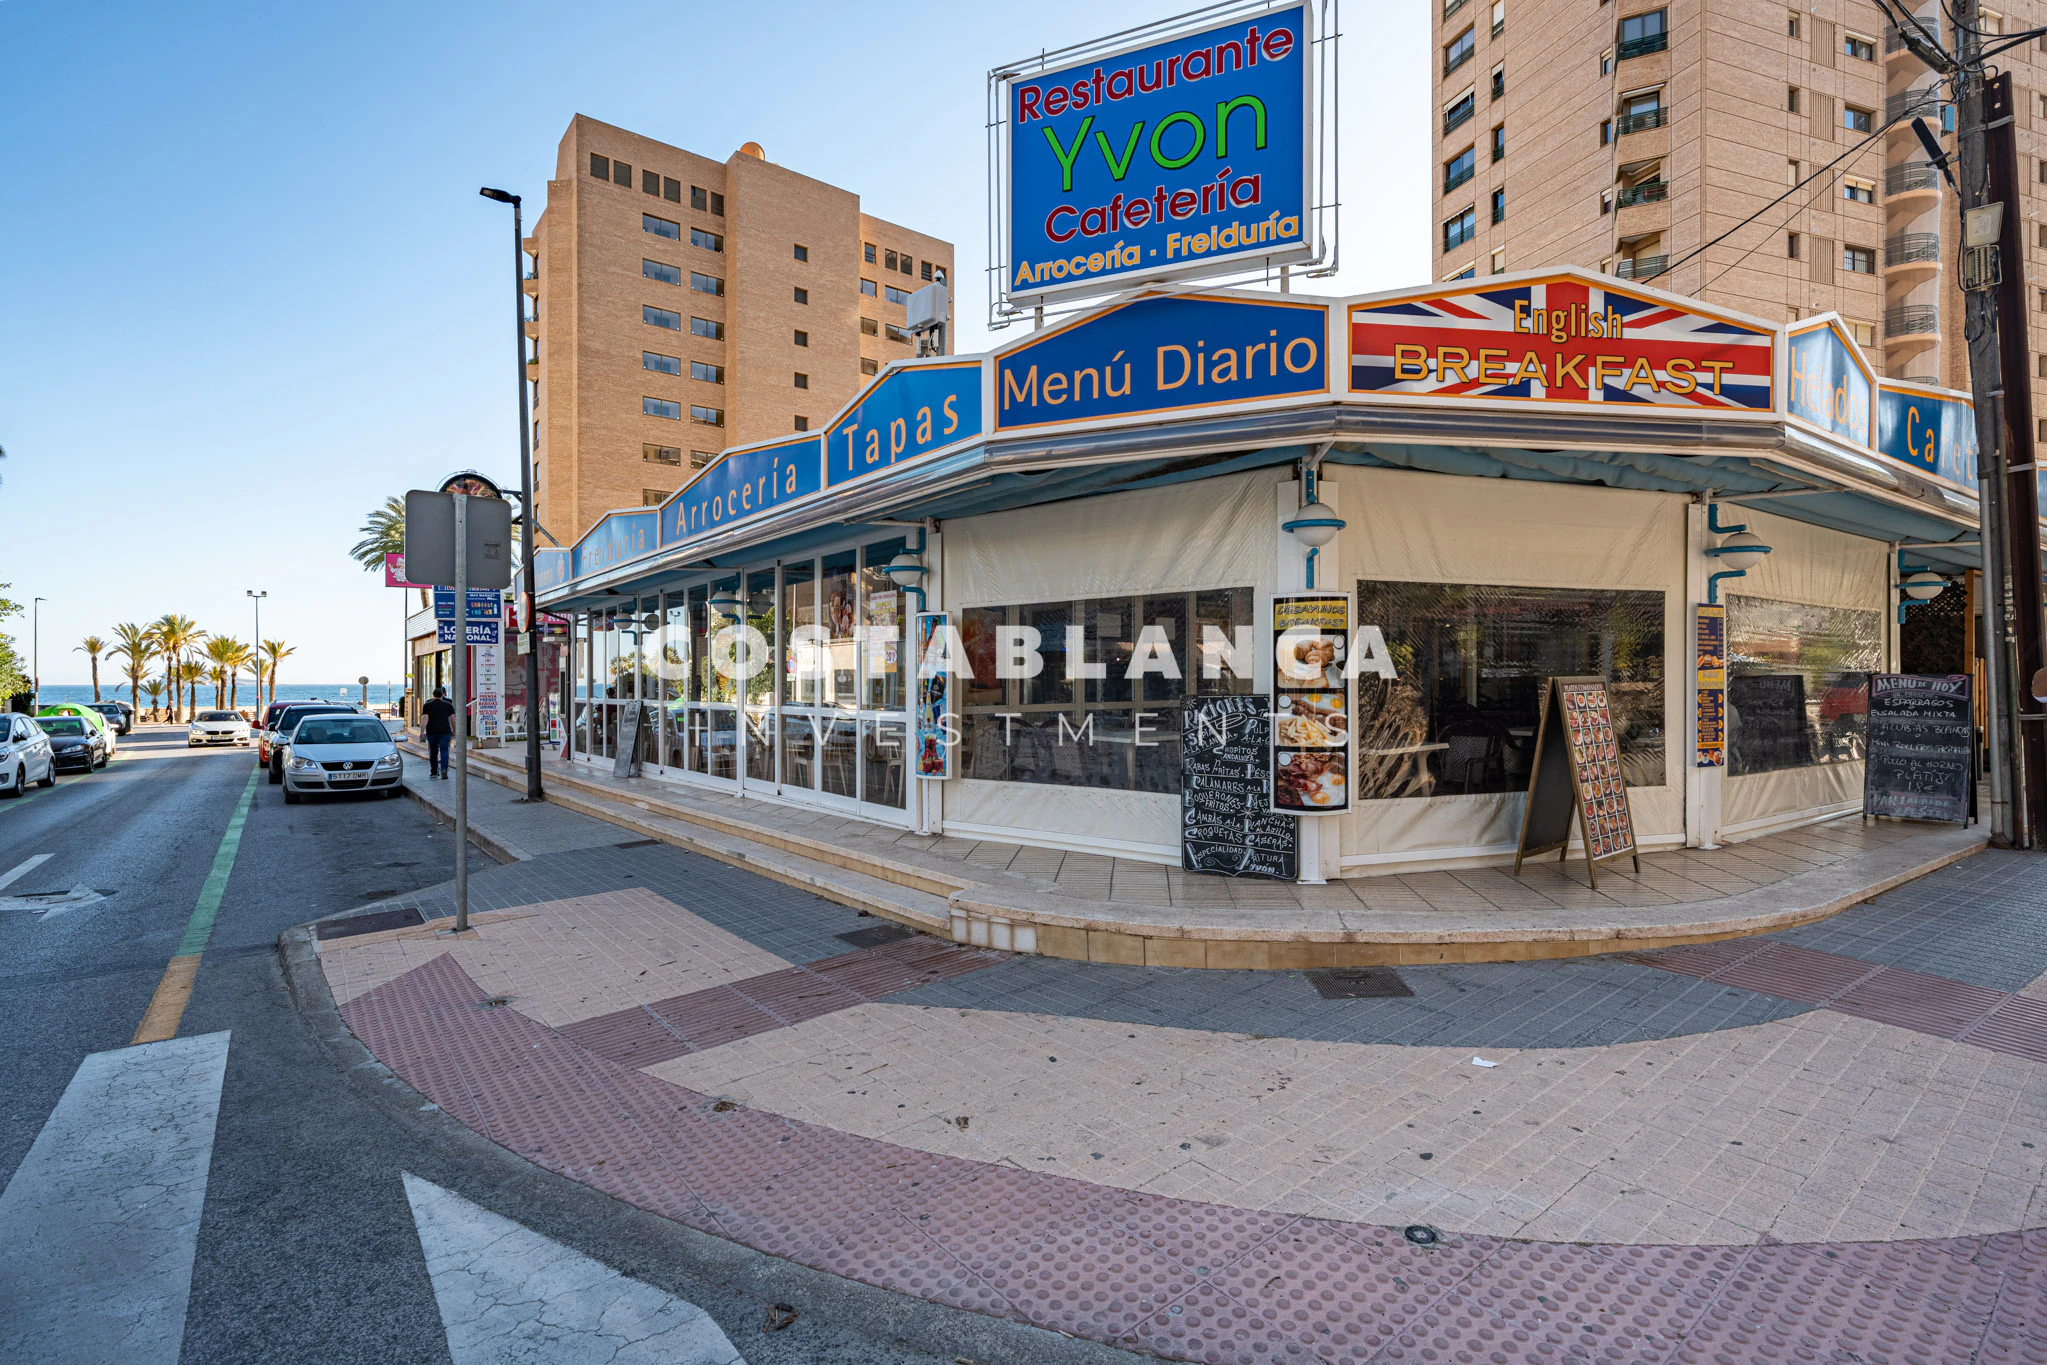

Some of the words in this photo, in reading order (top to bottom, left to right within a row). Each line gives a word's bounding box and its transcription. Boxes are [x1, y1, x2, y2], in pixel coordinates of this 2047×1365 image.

[1018, 26, 1294, 124] Restaurante
[1041, 94, 1267, 192] Yvon
[1045, 166, 1261, 243] Cafetería
[1014, 240, 1141, 286] Arrocería
[1166, 211, 1299, 259] Freiduría
[1513, 299, 1623, 343] English
[1003, 350, 1131, 410] Menú
[1157, 329, 1318, 391] Diario
[1393, 343, 1734, 395] BREAKFAST
[1790, 346, 1867, 434] Helados
[842, 394, 958, 471] Tapas
[1907, 406, 1973, 481] Cafet
[676, 457, 796, 535] Arrocería
[581, 522, 645, 572] Freiduría
[444, 625, 491, 634] LOERÍA
[1277, 604, 1346, 615] DESAYUNOS
[1278, 617, 1344, 628] BREAKFAST
[1884, 699, 1954, 707] ESPARRAGOS
[1931, 681, 1962, 693] HOY
[1245, 719, 1270, 734] PULP
